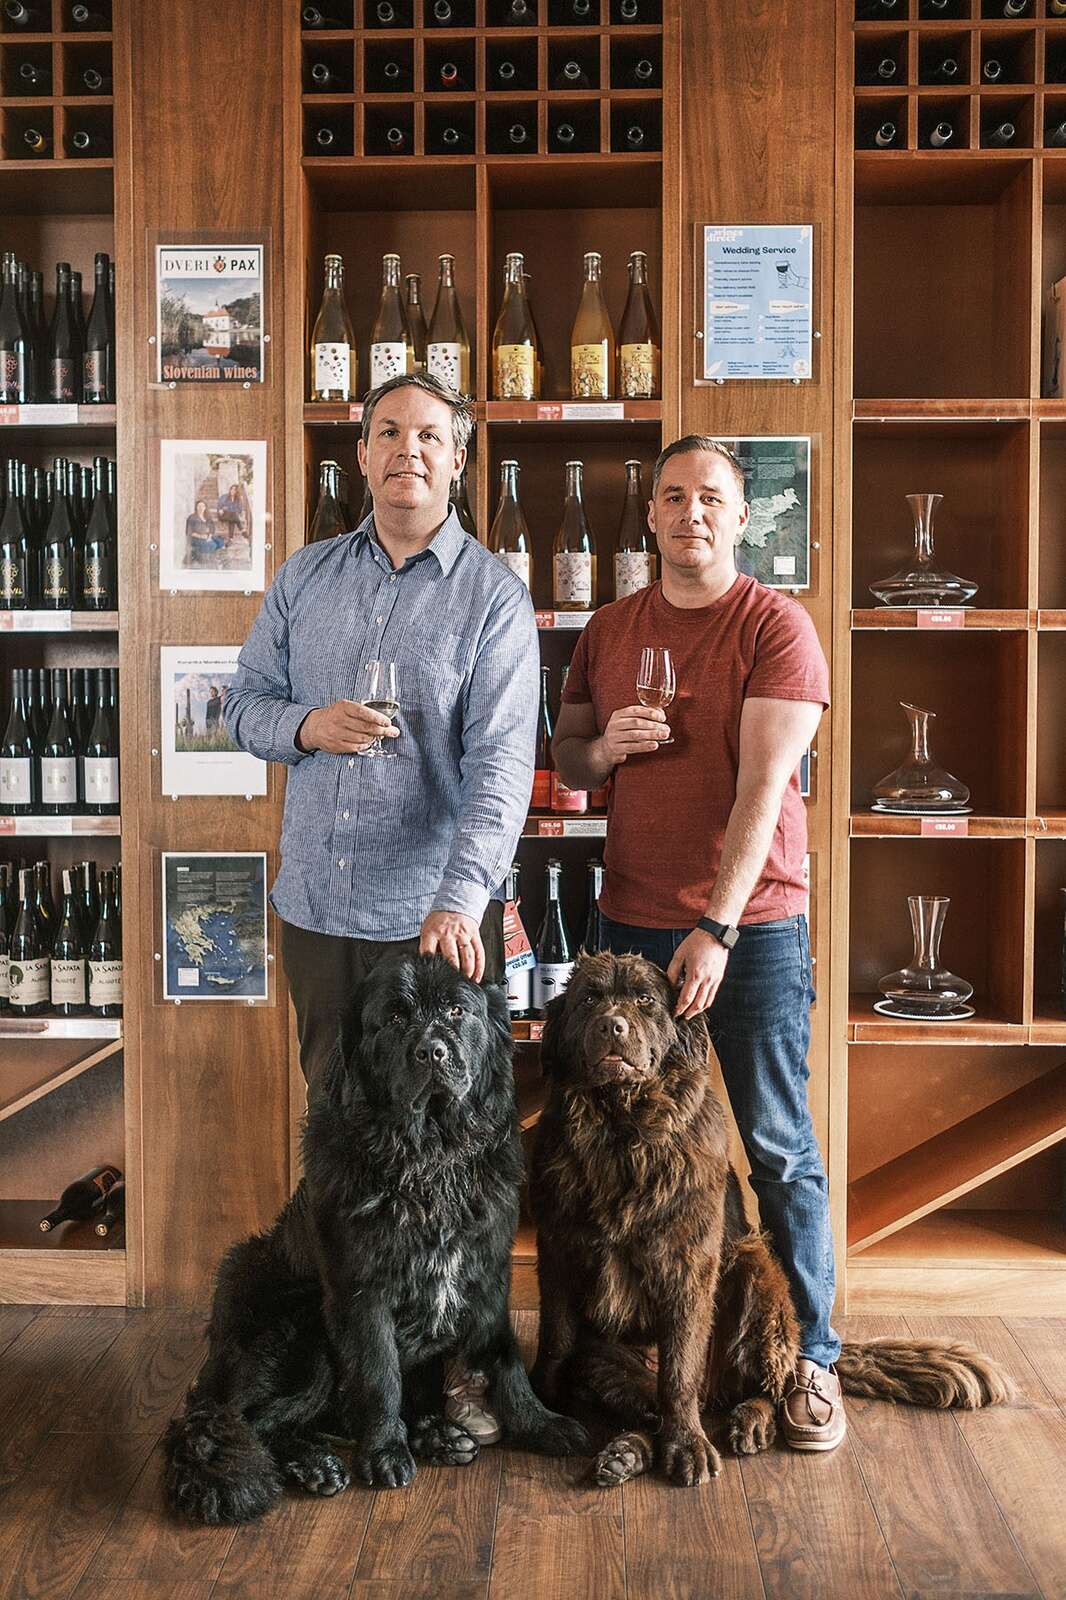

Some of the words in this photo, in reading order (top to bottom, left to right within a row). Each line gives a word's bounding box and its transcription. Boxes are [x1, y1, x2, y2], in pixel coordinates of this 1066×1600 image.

[722, 246, 761, 256] Wedding
[762, 246, 797, 255] Service
[164, 259, 209, 271] DVERI
[230, 259, 256, 271] PAX
[163, 364, 220, 379] Slovenian
[224, 365, 258, 379] wines
[102, 965, 123, 973] SAPAT
